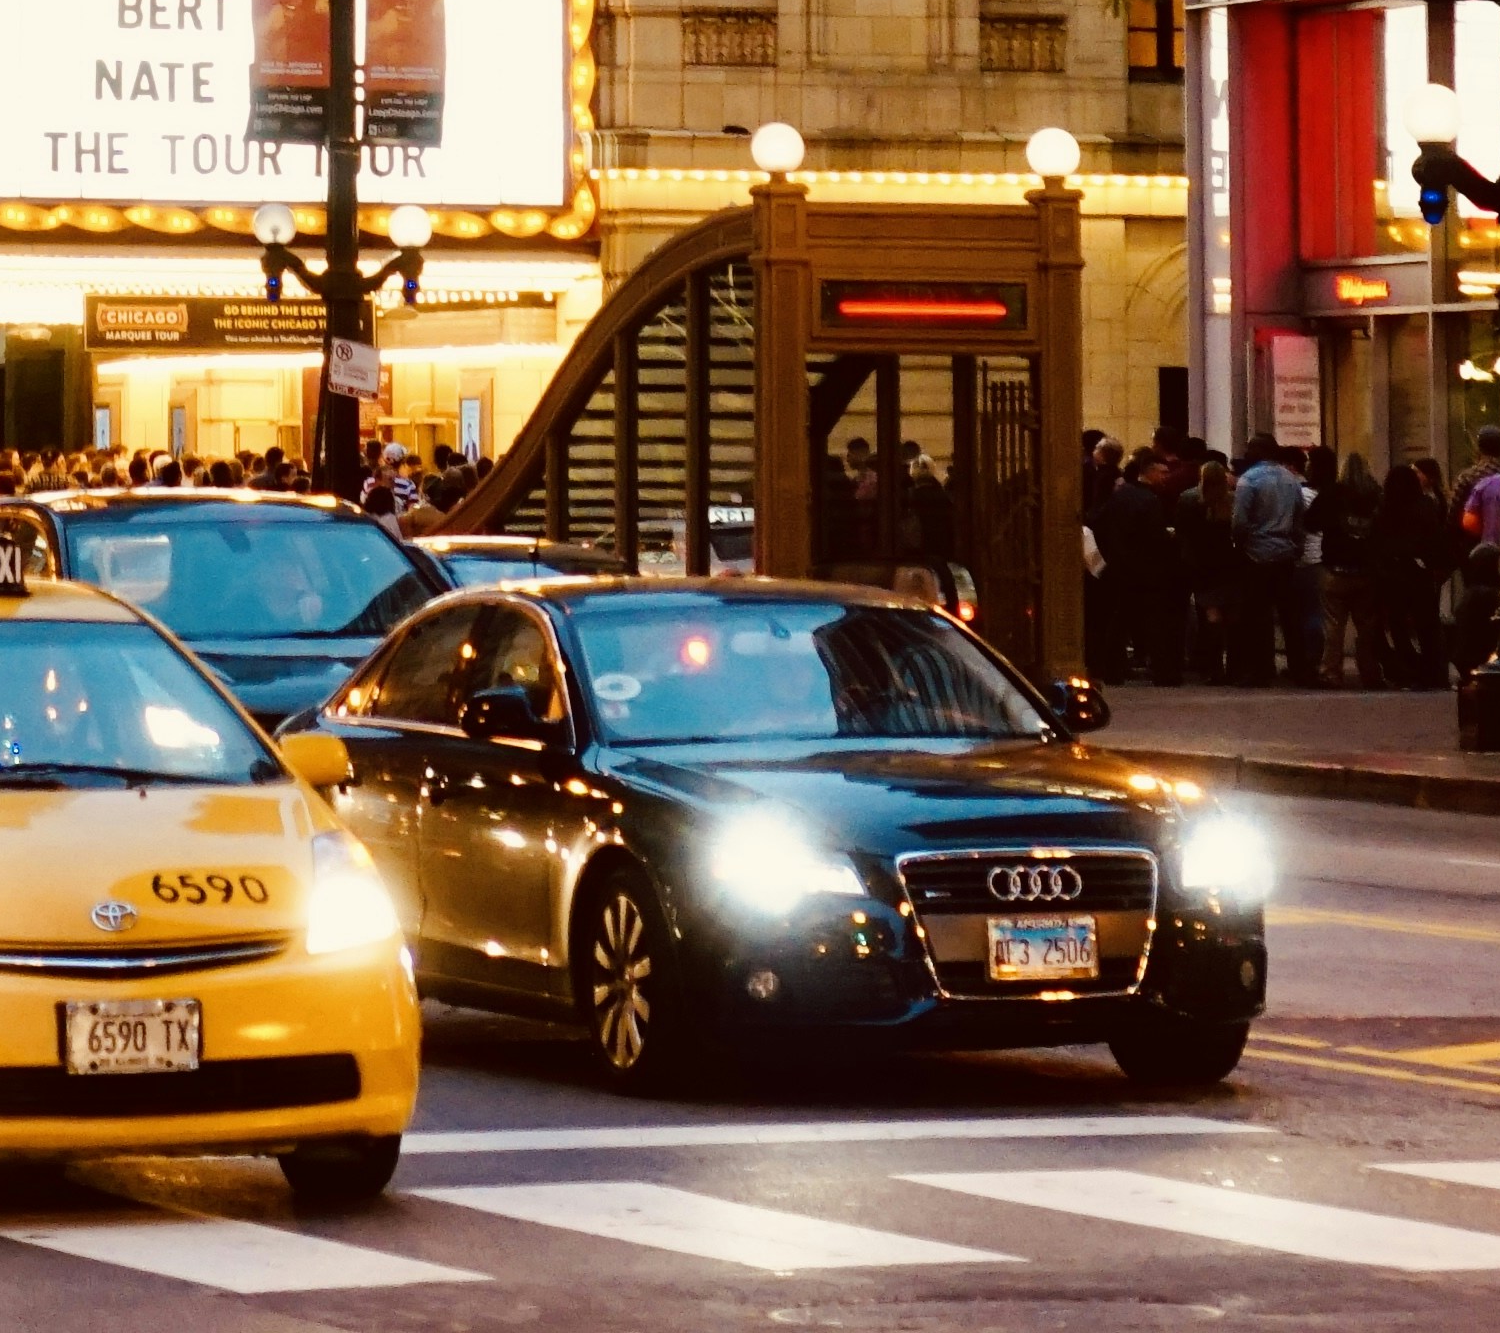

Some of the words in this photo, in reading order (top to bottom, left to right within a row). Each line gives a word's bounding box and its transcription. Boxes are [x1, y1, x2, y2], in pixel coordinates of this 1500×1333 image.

[95, 60, 214, 104] NATE
[44, 132, 129, 175] THE
[161, 135, 282, 177] TOUR
[105, 310, 179, 325] CHICAGO
[213, 318, 233, 330] THE
[234, 318, 270, 330] ICONIC
[271, 318, 317, 331] CHICAGO
[224, 304, 239, 316] GO
[241, 305, 278, 317] BEHIND
[280, 305, 299, 317] THE
[300, 305, 327, 317] SCEN
[105, 330, 152, 341] MARQUEE
[155, 330, 180, 341] TOUR
[151, 873, 270, 905] 6590
[1043, 935, 1091, 965] 2506
[88, 1020, 147, 1053] 6590
[162, 1019, 190, 1052] TX
